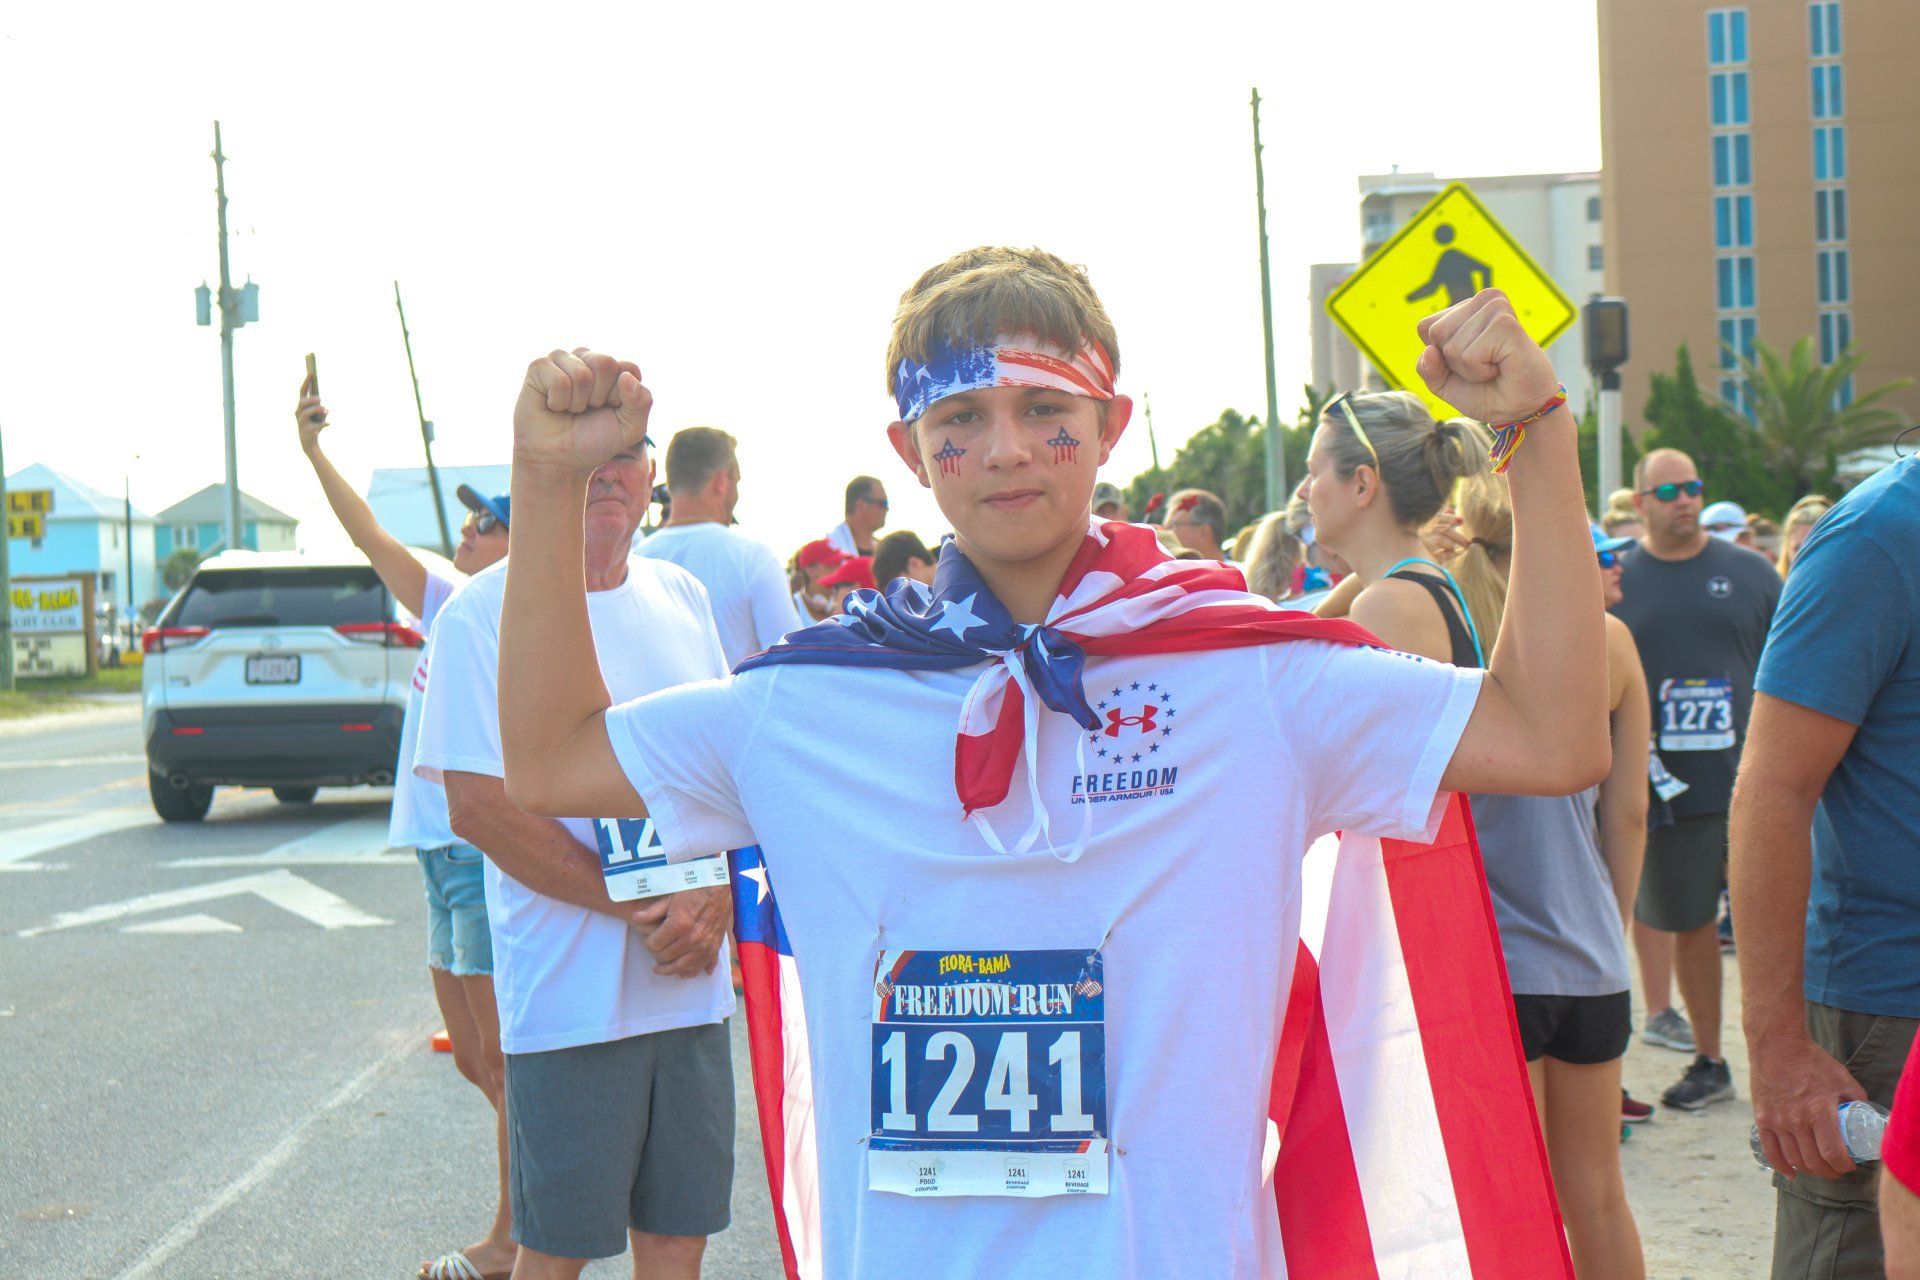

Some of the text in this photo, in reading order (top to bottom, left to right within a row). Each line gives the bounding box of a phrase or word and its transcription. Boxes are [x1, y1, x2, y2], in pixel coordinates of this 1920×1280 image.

[1663, 700, 1732, 731] 1273
[1072, 767, 1178, 794] FREEDOM
[1108, 791, 1153, 802] ARMOUR
[1159, 788, 1174, 796] USA
[939, 953, 1012, 975] FLORA-BAMA
[894, 983, 1073, 1016] FREEDOM RUN
[881, 1031, 1094, 1132] 1241
[919, 1167, 936, 1176] 1241
[1008, 1168, 1026, 1177] 1241
[1067, 1170, 1086, 1179] 1241
